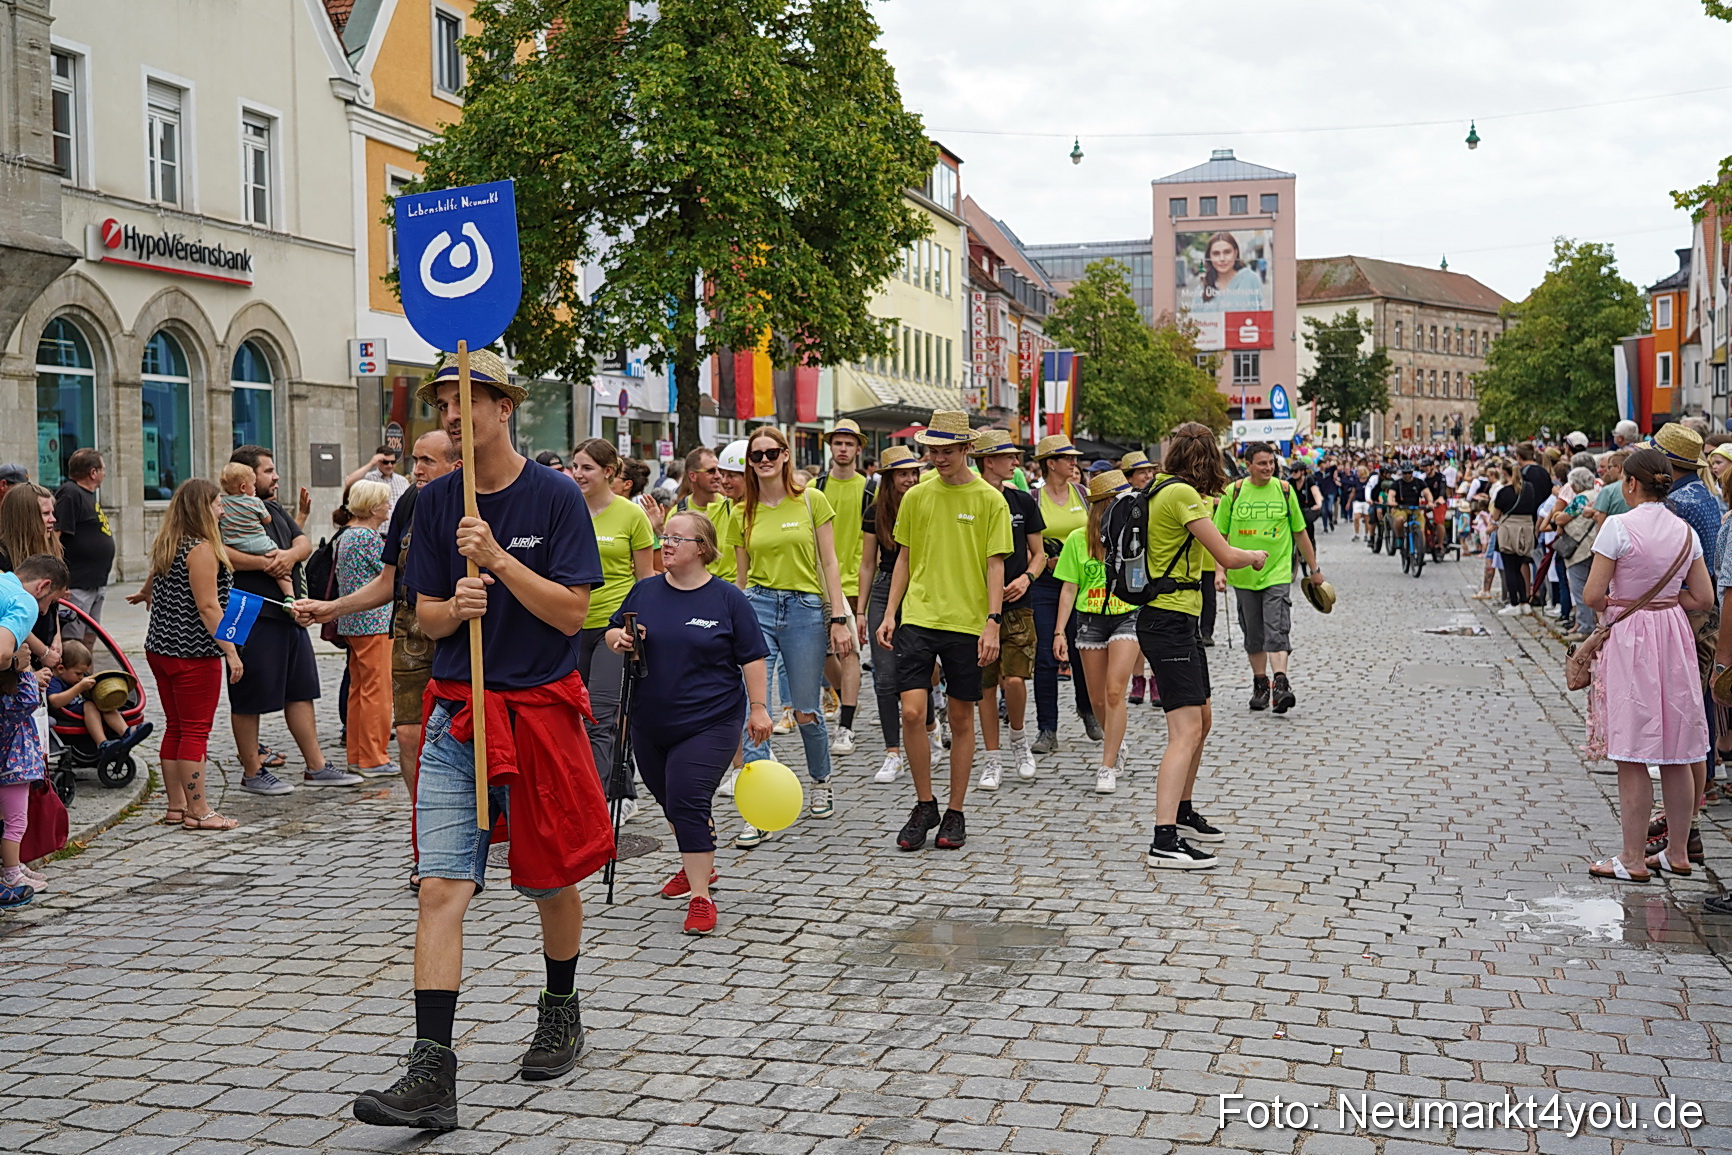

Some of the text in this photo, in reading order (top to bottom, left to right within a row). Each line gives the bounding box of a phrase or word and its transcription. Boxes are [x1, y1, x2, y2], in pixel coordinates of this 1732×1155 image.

[408, 191, 499, 217] Lebenshilfe Neumarkt
[124, 224, 253, 273] HypoVereinsbank
[387, 437, 403, 449] 20%
[1237, 502, 1283, 519] OPF
